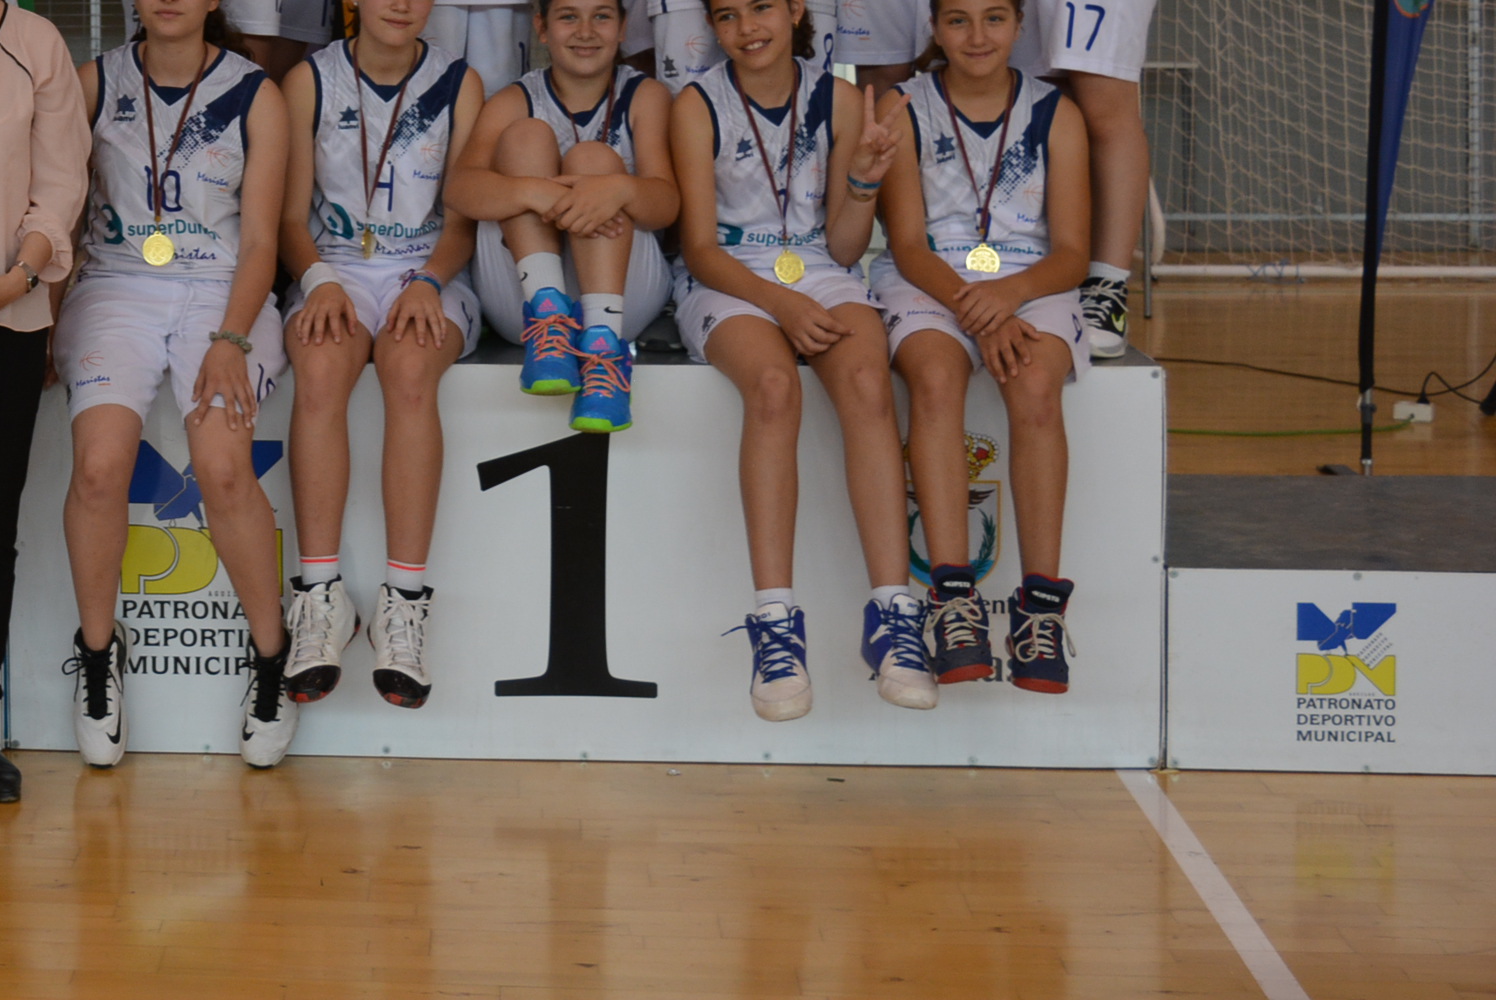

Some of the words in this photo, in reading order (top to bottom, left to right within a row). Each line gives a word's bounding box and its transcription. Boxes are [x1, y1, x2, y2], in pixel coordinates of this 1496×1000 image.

[1065, 1, 1107, 52] 17
[144, 165, 184, 213] 10
[476, 432, 658, 698] 1
[1296, 697, 1396, 711] PATRONATO
[1296, 713, 1396, 727] DEPORTIVO
[1296, 730, 1396, 743] MUNICIPAL
